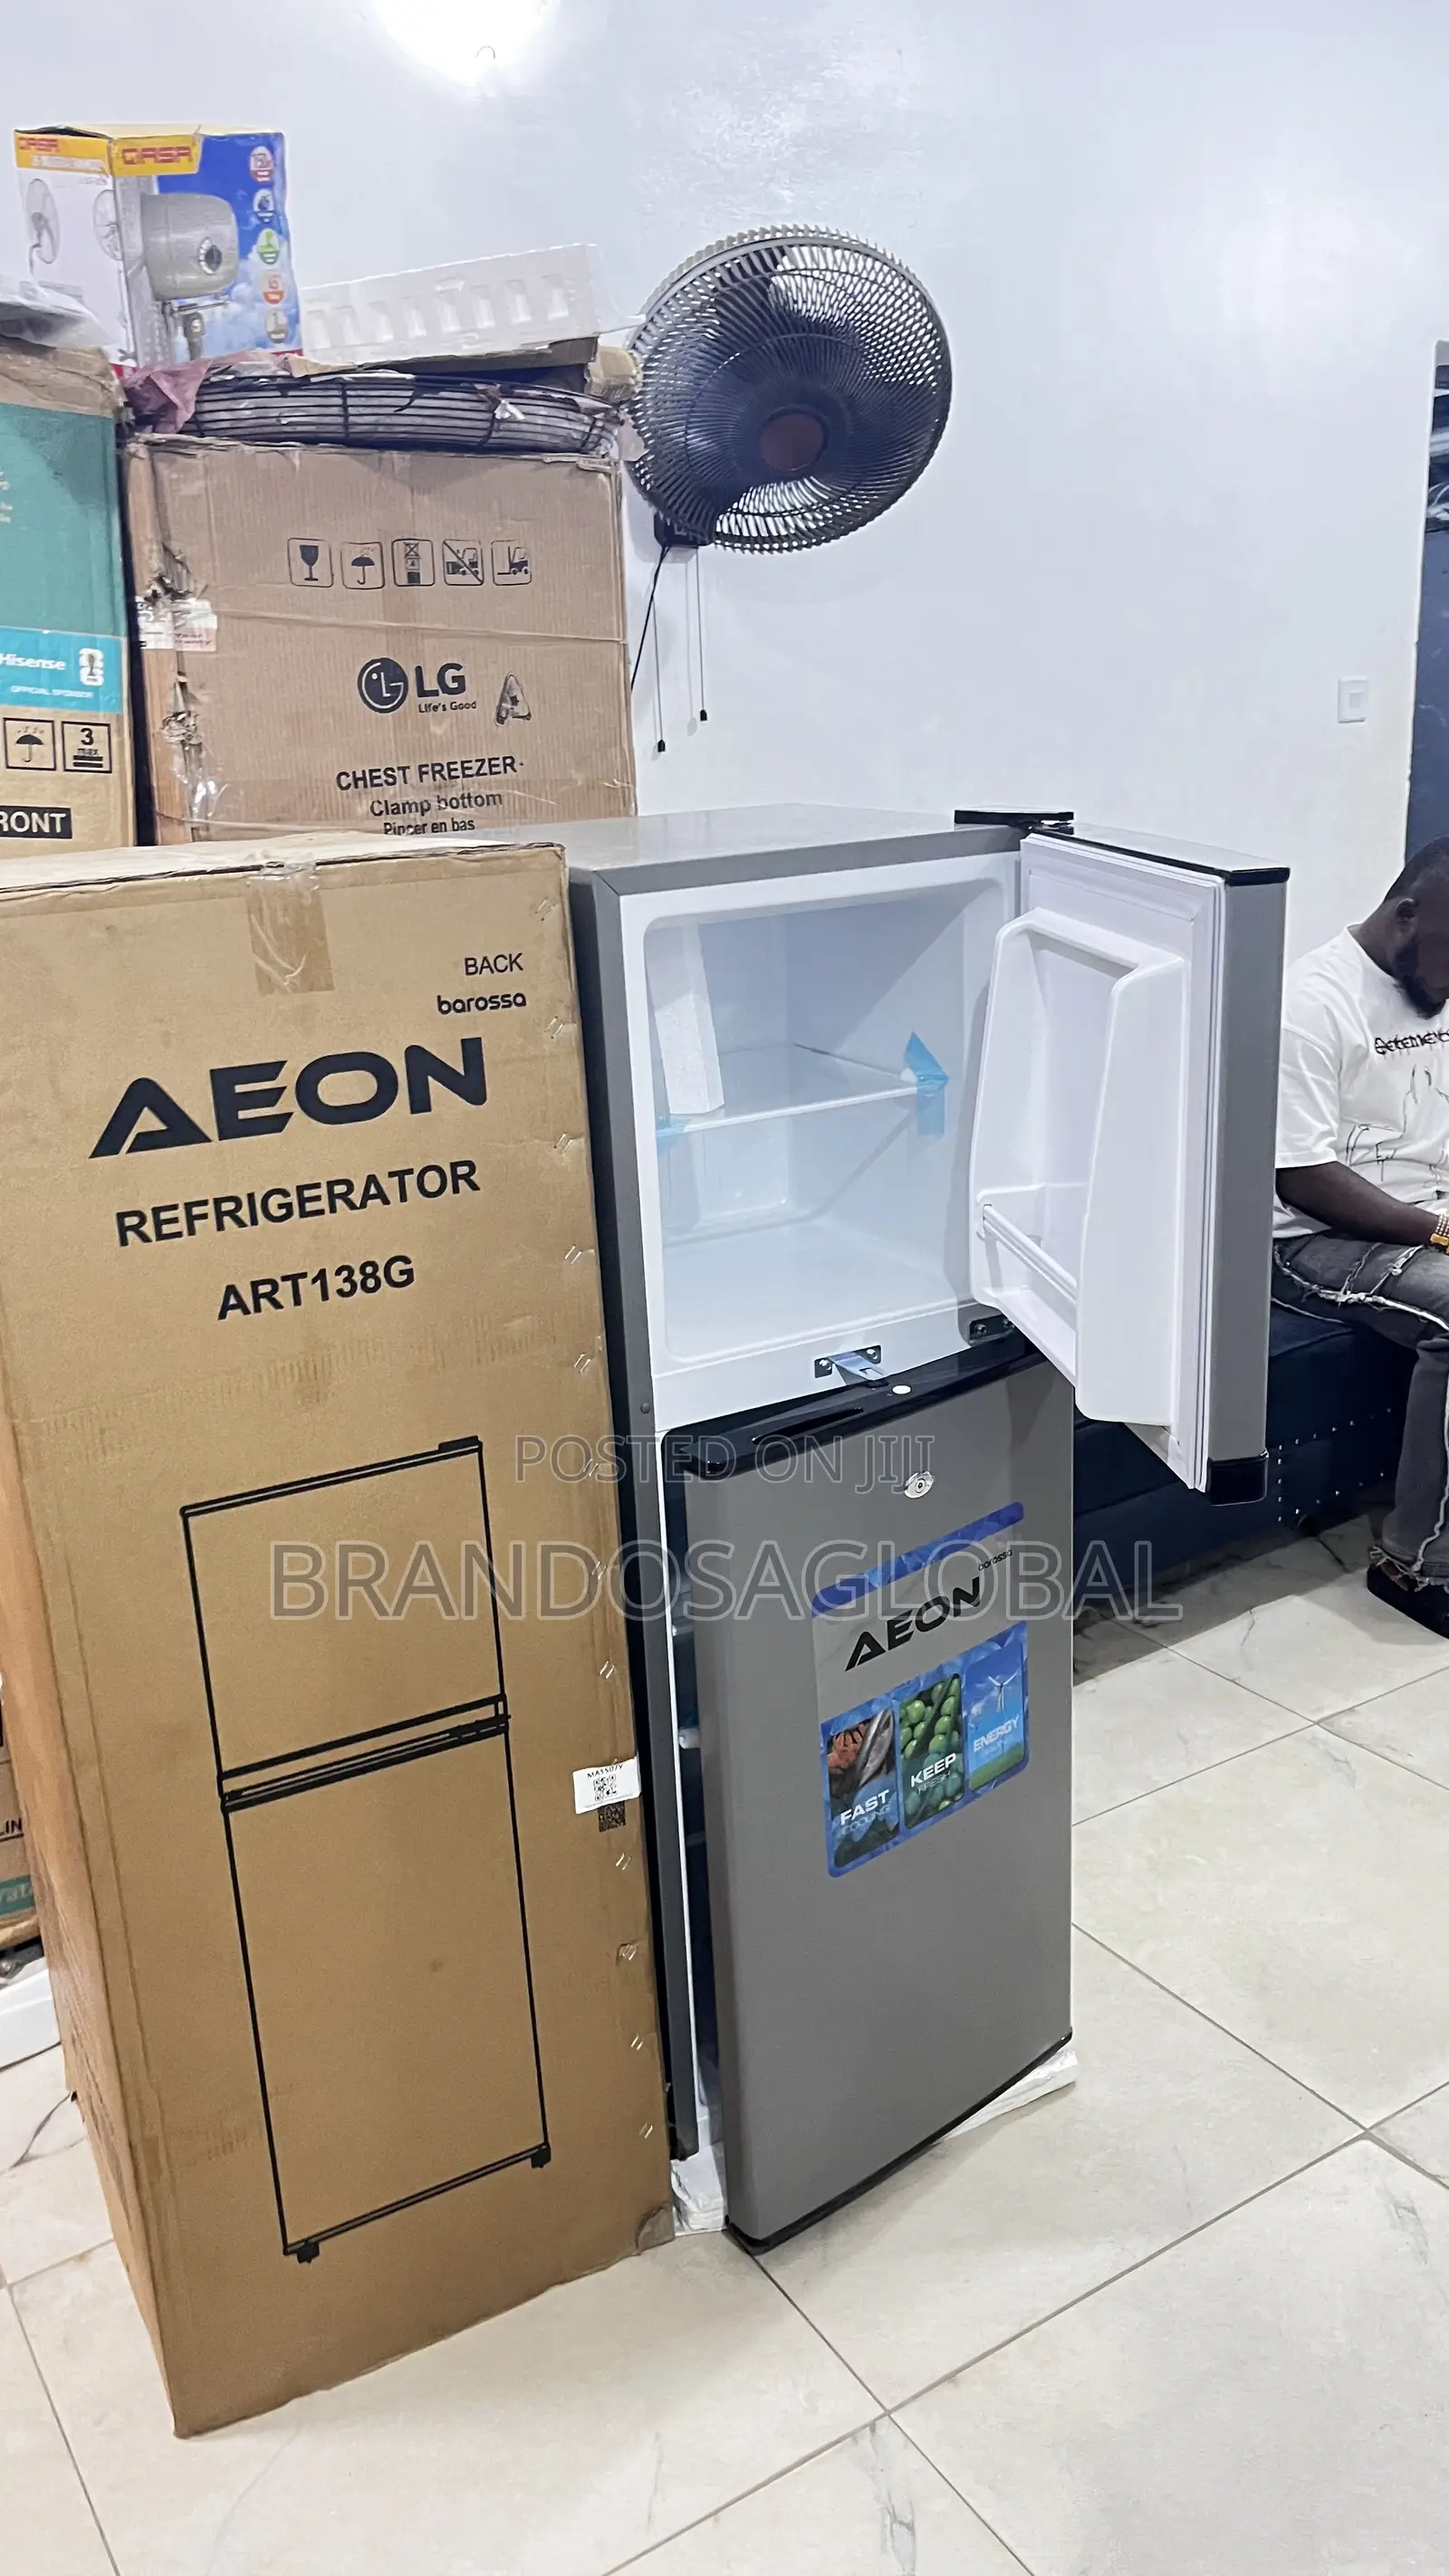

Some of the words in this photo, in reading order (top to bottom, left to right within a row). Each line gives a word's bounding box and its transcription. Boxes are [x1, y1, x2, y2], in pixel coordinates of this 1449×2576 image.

[415, 662, 466, 697] LG
[449, 700, 477, 711] Good
[80, 727, 94, 745] 3
[336, 765, 410, 790] CHEST
[369, 799, 431, 817] Clamp
[437, 792, 503, 810] bottom
[431, 820, 447, 834] en
[451, 818, 475, 832] bas
[464, 953, 524, 976] BACK
[437, 991, 527, 1015] barossa
[88, 1037, 487, 1159] AEON
[116, 1160, 481, 1247] REFRIGERATOR
[217, 1255, 415, 1320] ART138G
[844, 1575, 983, 1671] AEON
[973, 1713, 1020, 1753] ENERGY
[911, 1752, 956, 1788] KEEP
[840, 1788, 890, 1826] FAST
